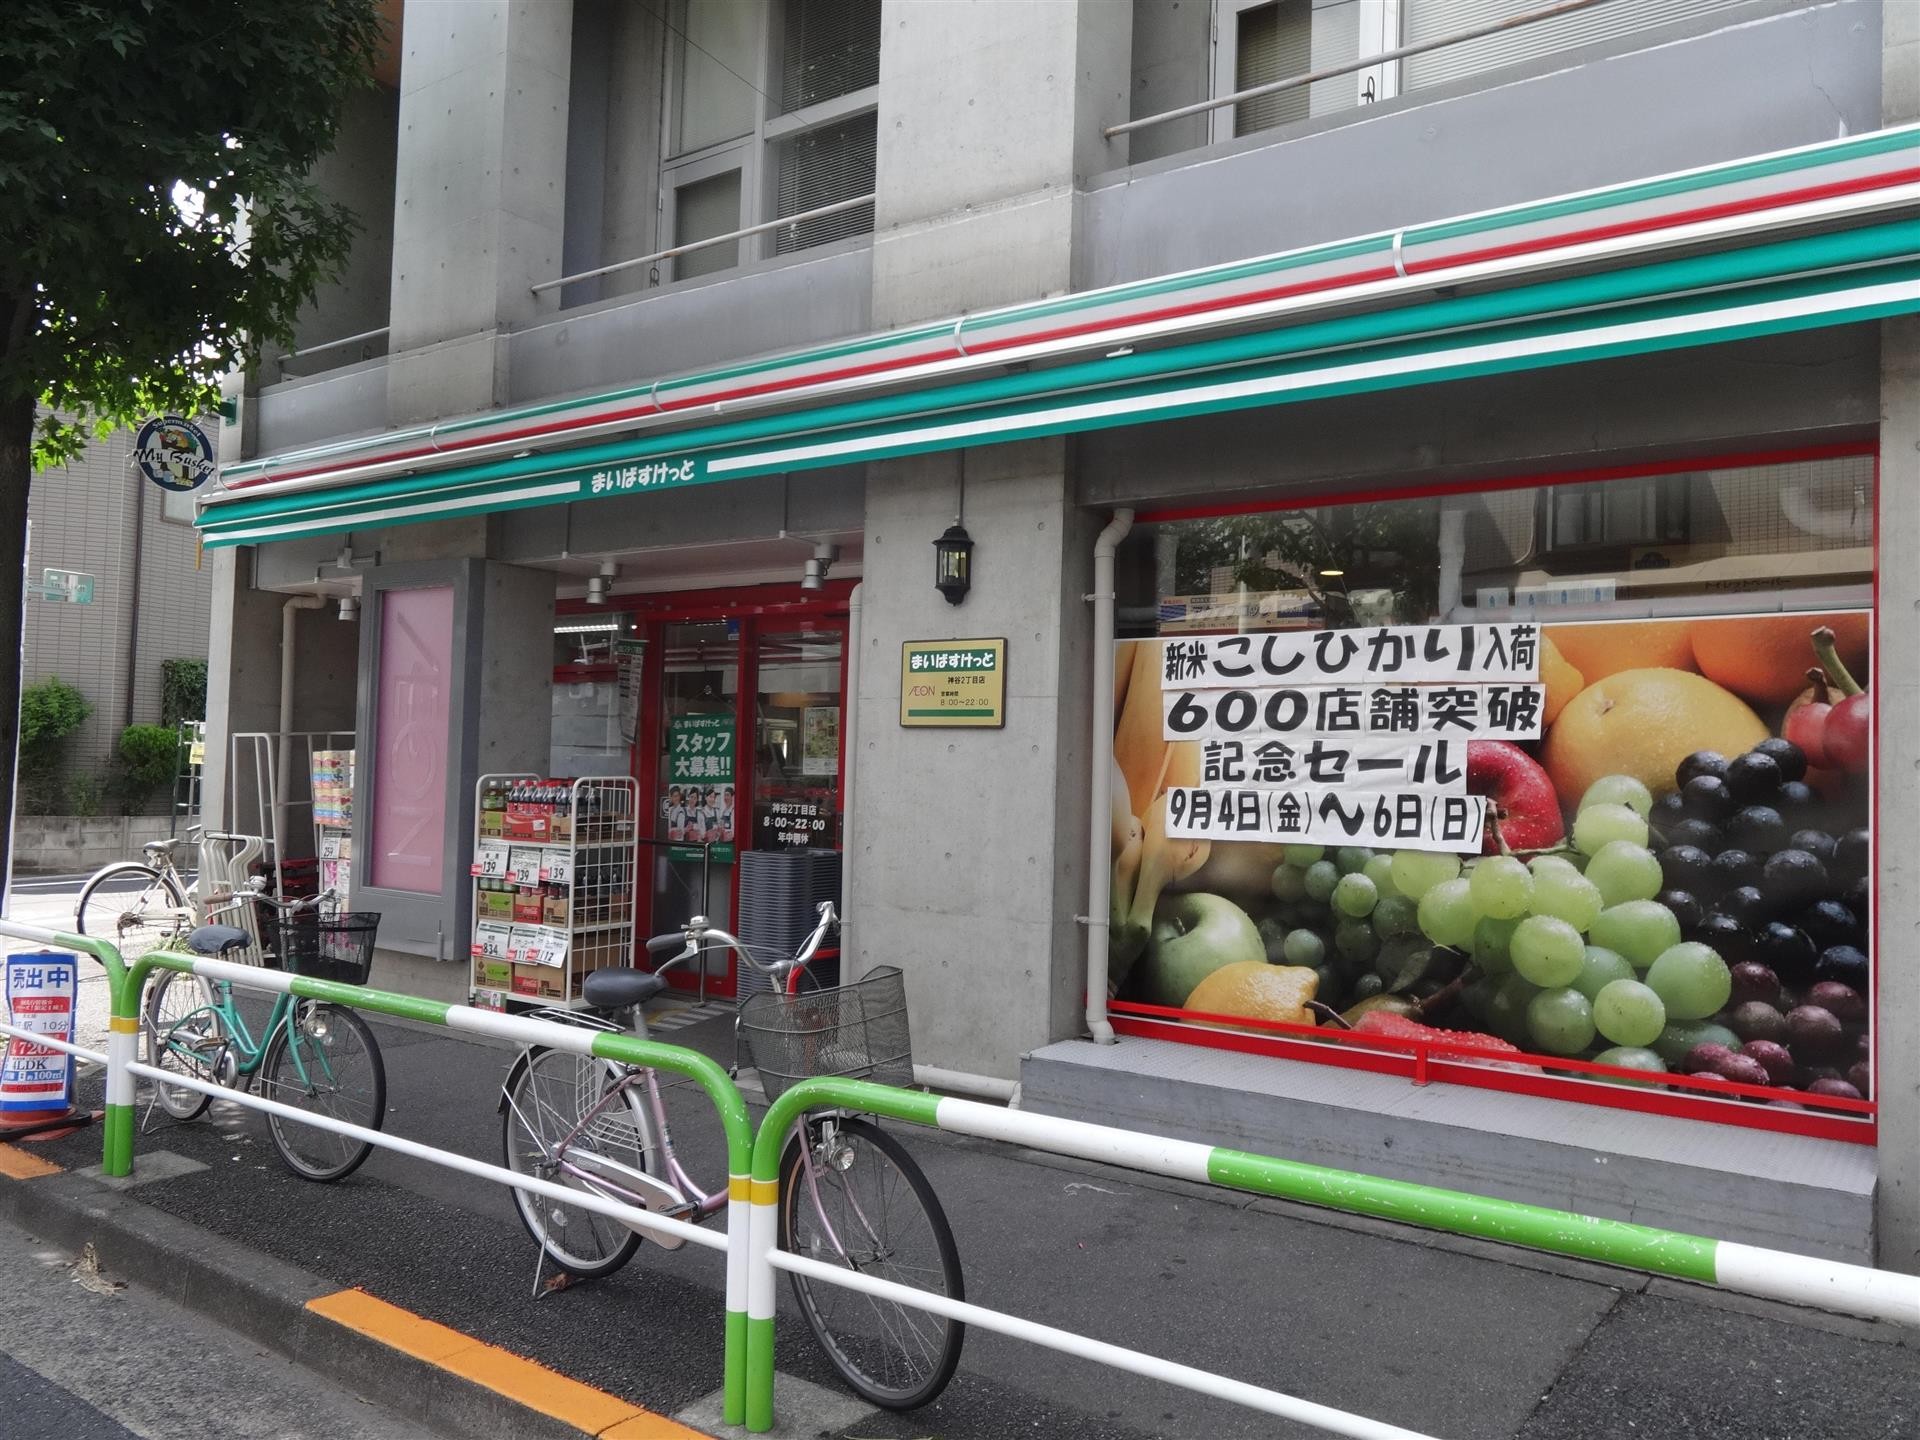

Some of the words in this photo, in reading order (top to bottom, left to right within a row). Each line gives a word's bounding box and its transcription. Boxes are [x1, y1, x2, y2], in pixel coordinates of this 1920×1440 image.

[133, 448, 163, 463] My
[170, 450, 215, 474] Basket
[591, 459, 695, 494] まいばすけっと
[911, 652, 994, 669] まいばすけっと
[1165, 624, 1537, 682] 新米こしひかり入荷
[947, 675, 986, 685] 神谷2丁目店
[1167, 686, 1542, 733] 600店舗突破
[675, 732, 731, 753] スタッフ
[675, 756, 731, 777] 大募集!!
[1204, 740, 1462, 785] 記念セール
[771, 802, 817, 817] 神谷2丁目店
[483, 861, 496, 873] 139
[517, 868, 530, 882] 139
[549, 866, 565, 879] 139
[483, 942, 499, 955] 834
[13, 966, 69, 989] 売出中
[43, 1020, 69, 1031] 10分
